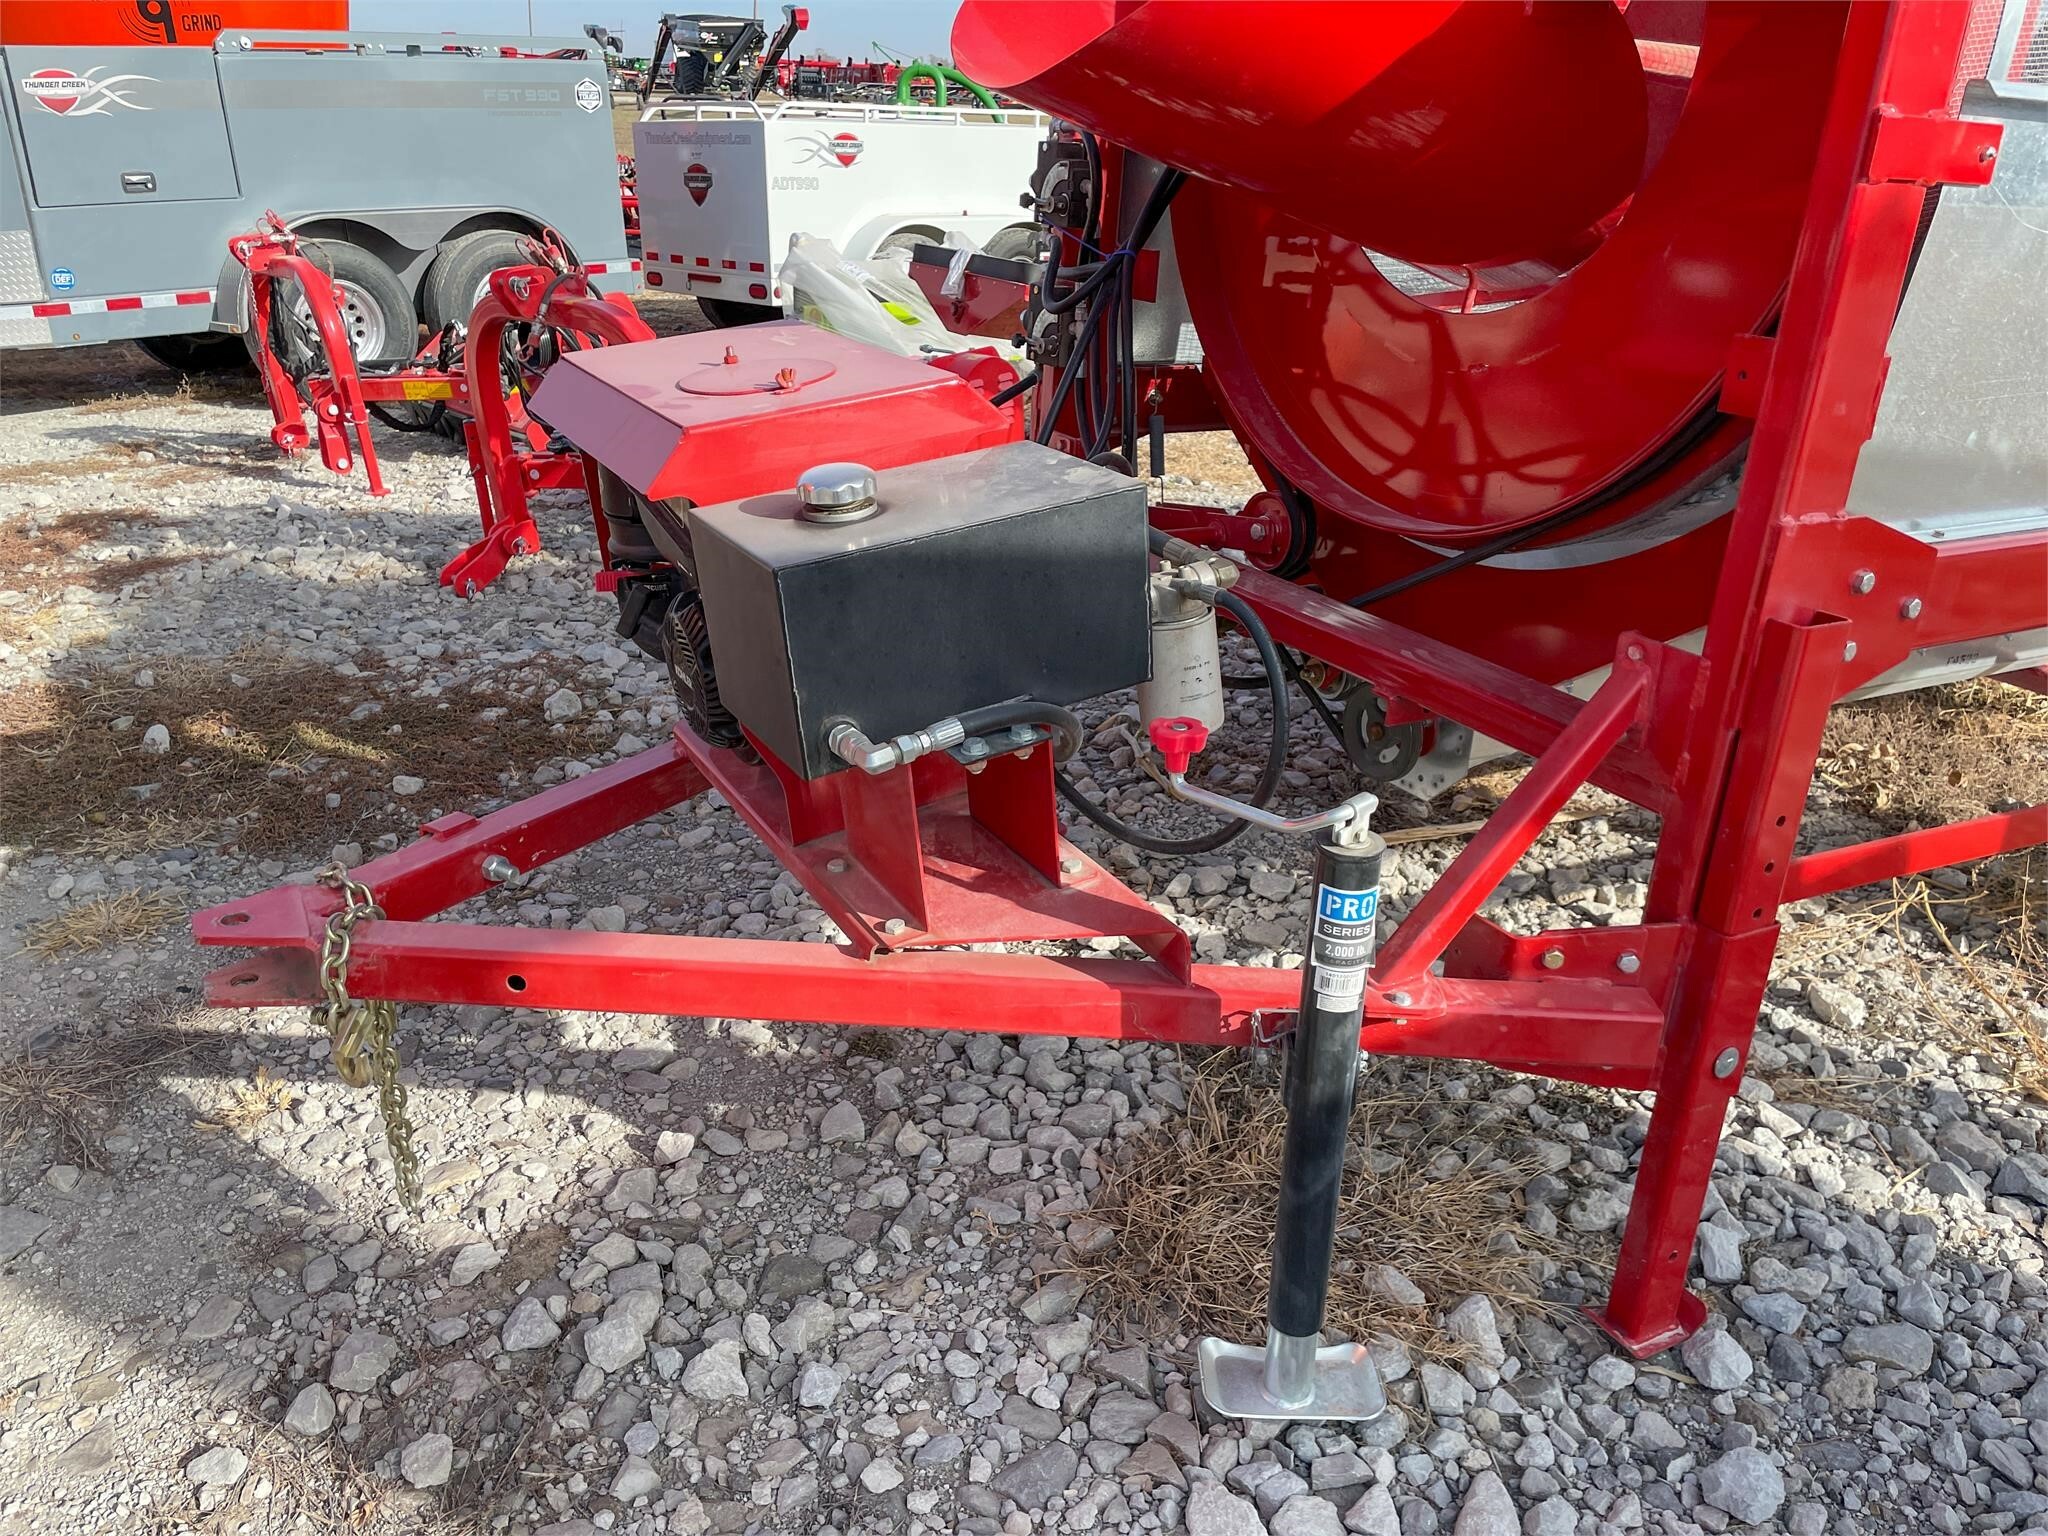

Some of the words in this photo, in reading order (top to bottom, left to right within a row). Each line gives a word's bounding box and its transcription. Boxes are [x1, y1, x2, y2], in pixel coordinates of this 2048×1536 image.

[181, 14, 222, 31] GRIND
[483, 88, 522, 102] FST
[524, 88, 561, 102] 990
[771, 176, 820, 190] ADT990
[1325, 894, 1374, 919] PRO
[1323, 923, 1372, 937] SERIES
[1325, 943, 1354, 957] 2,000
